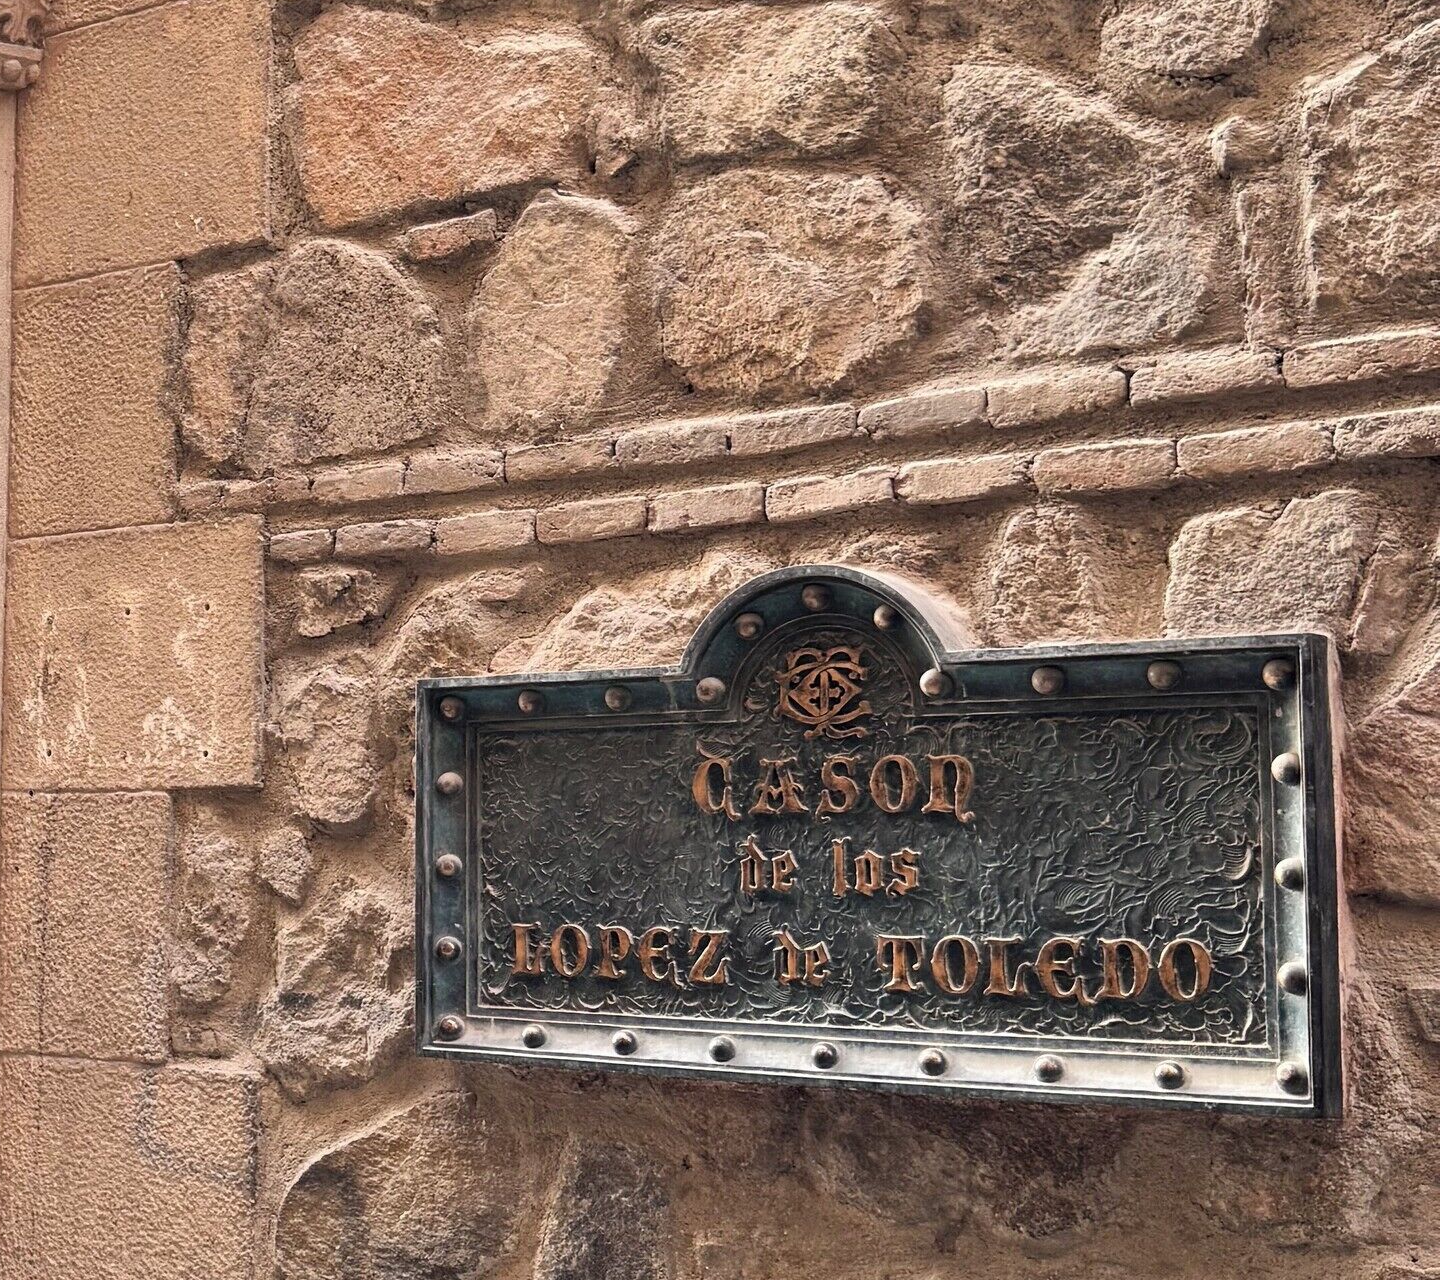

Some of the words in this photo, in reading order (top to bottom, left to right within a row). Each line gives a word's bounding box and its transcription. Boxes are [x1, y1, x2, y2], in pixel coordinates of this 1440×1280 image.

[691, 752, 976, 823] CASON
[739, 835, 798, 896] de
[832, 836, 921, 898] los
[510, 922, 730, 986] LOPEZ
[773, 926, 832, 988] de
[875, 933, 1214, 1006] TOLEDO
